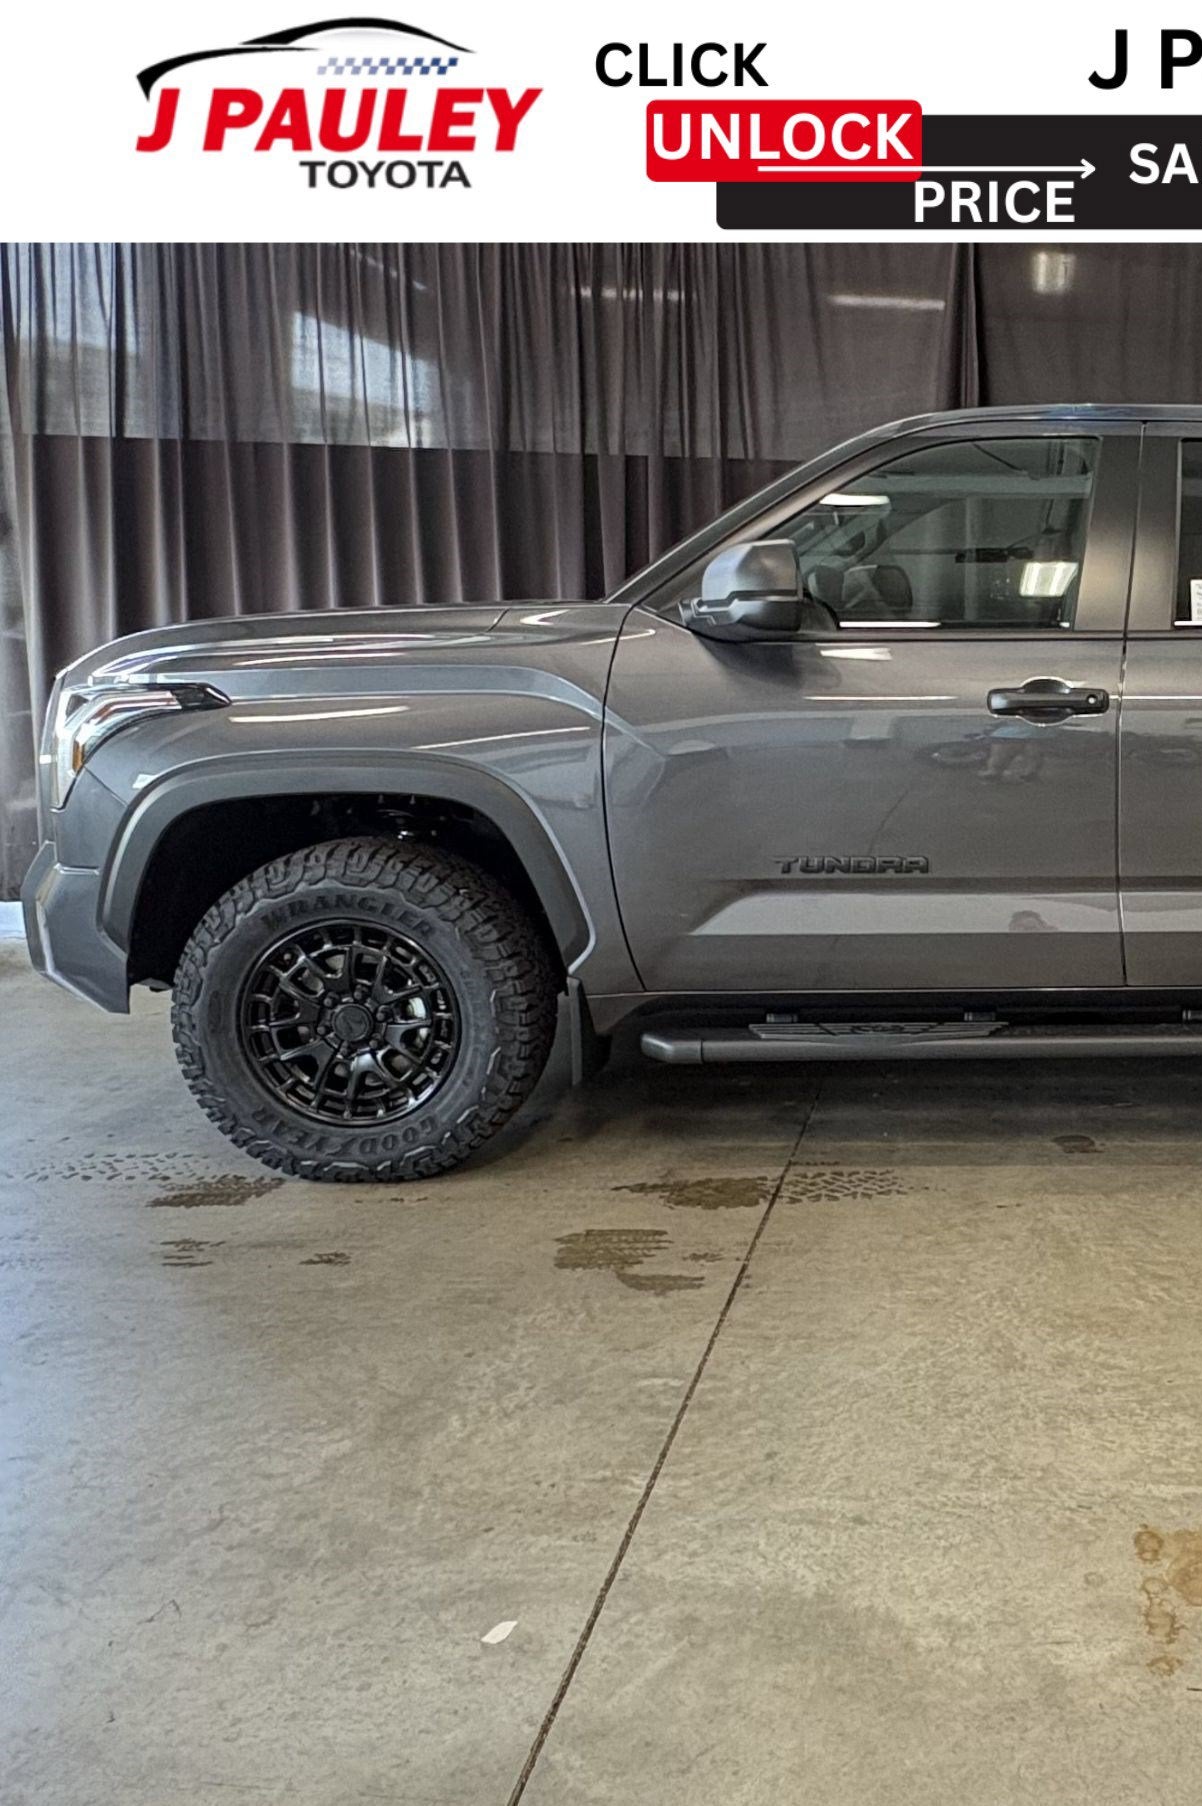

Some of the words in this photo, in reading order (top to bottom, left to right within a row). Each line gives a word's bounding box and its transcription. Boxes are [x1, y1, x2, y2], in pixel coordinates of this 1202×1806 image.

[774, 855, 930, 875] TUNDRA
[261, 894, 435, 940] WRANGLER
[252, 1105, 438, 1155] GOODYEAR
